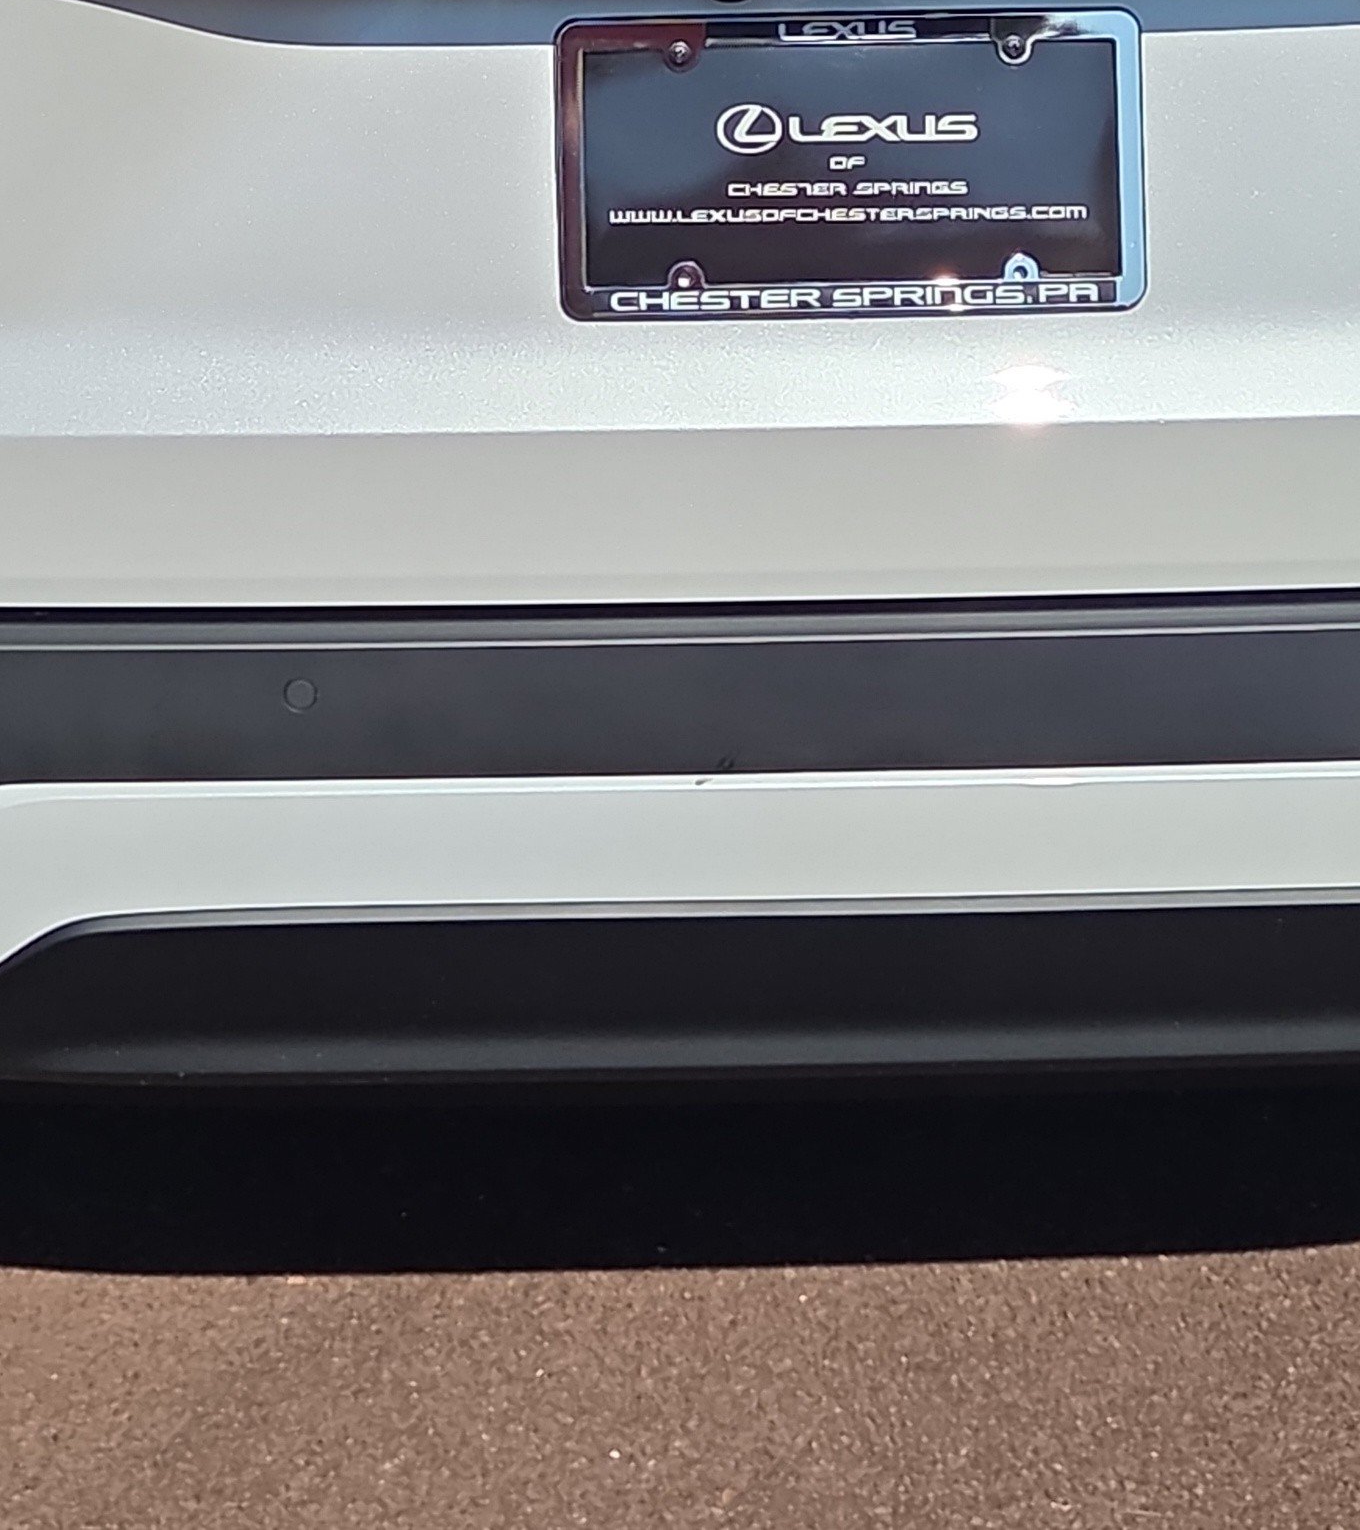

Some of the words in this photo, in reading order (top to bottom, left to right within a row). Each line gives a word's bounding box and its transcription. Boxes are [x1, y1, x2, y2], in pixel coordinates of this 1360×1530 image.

[777, 20, 916, 41] LEXUS
[789, 114, 979, 142] LEXUS
[829, 156, 866, 170] OF
[727, 182, 848, 197] CHESTER
[852, 180, 969, 196] SPRINGS
[610, 289, 821, 312] CHESTER
